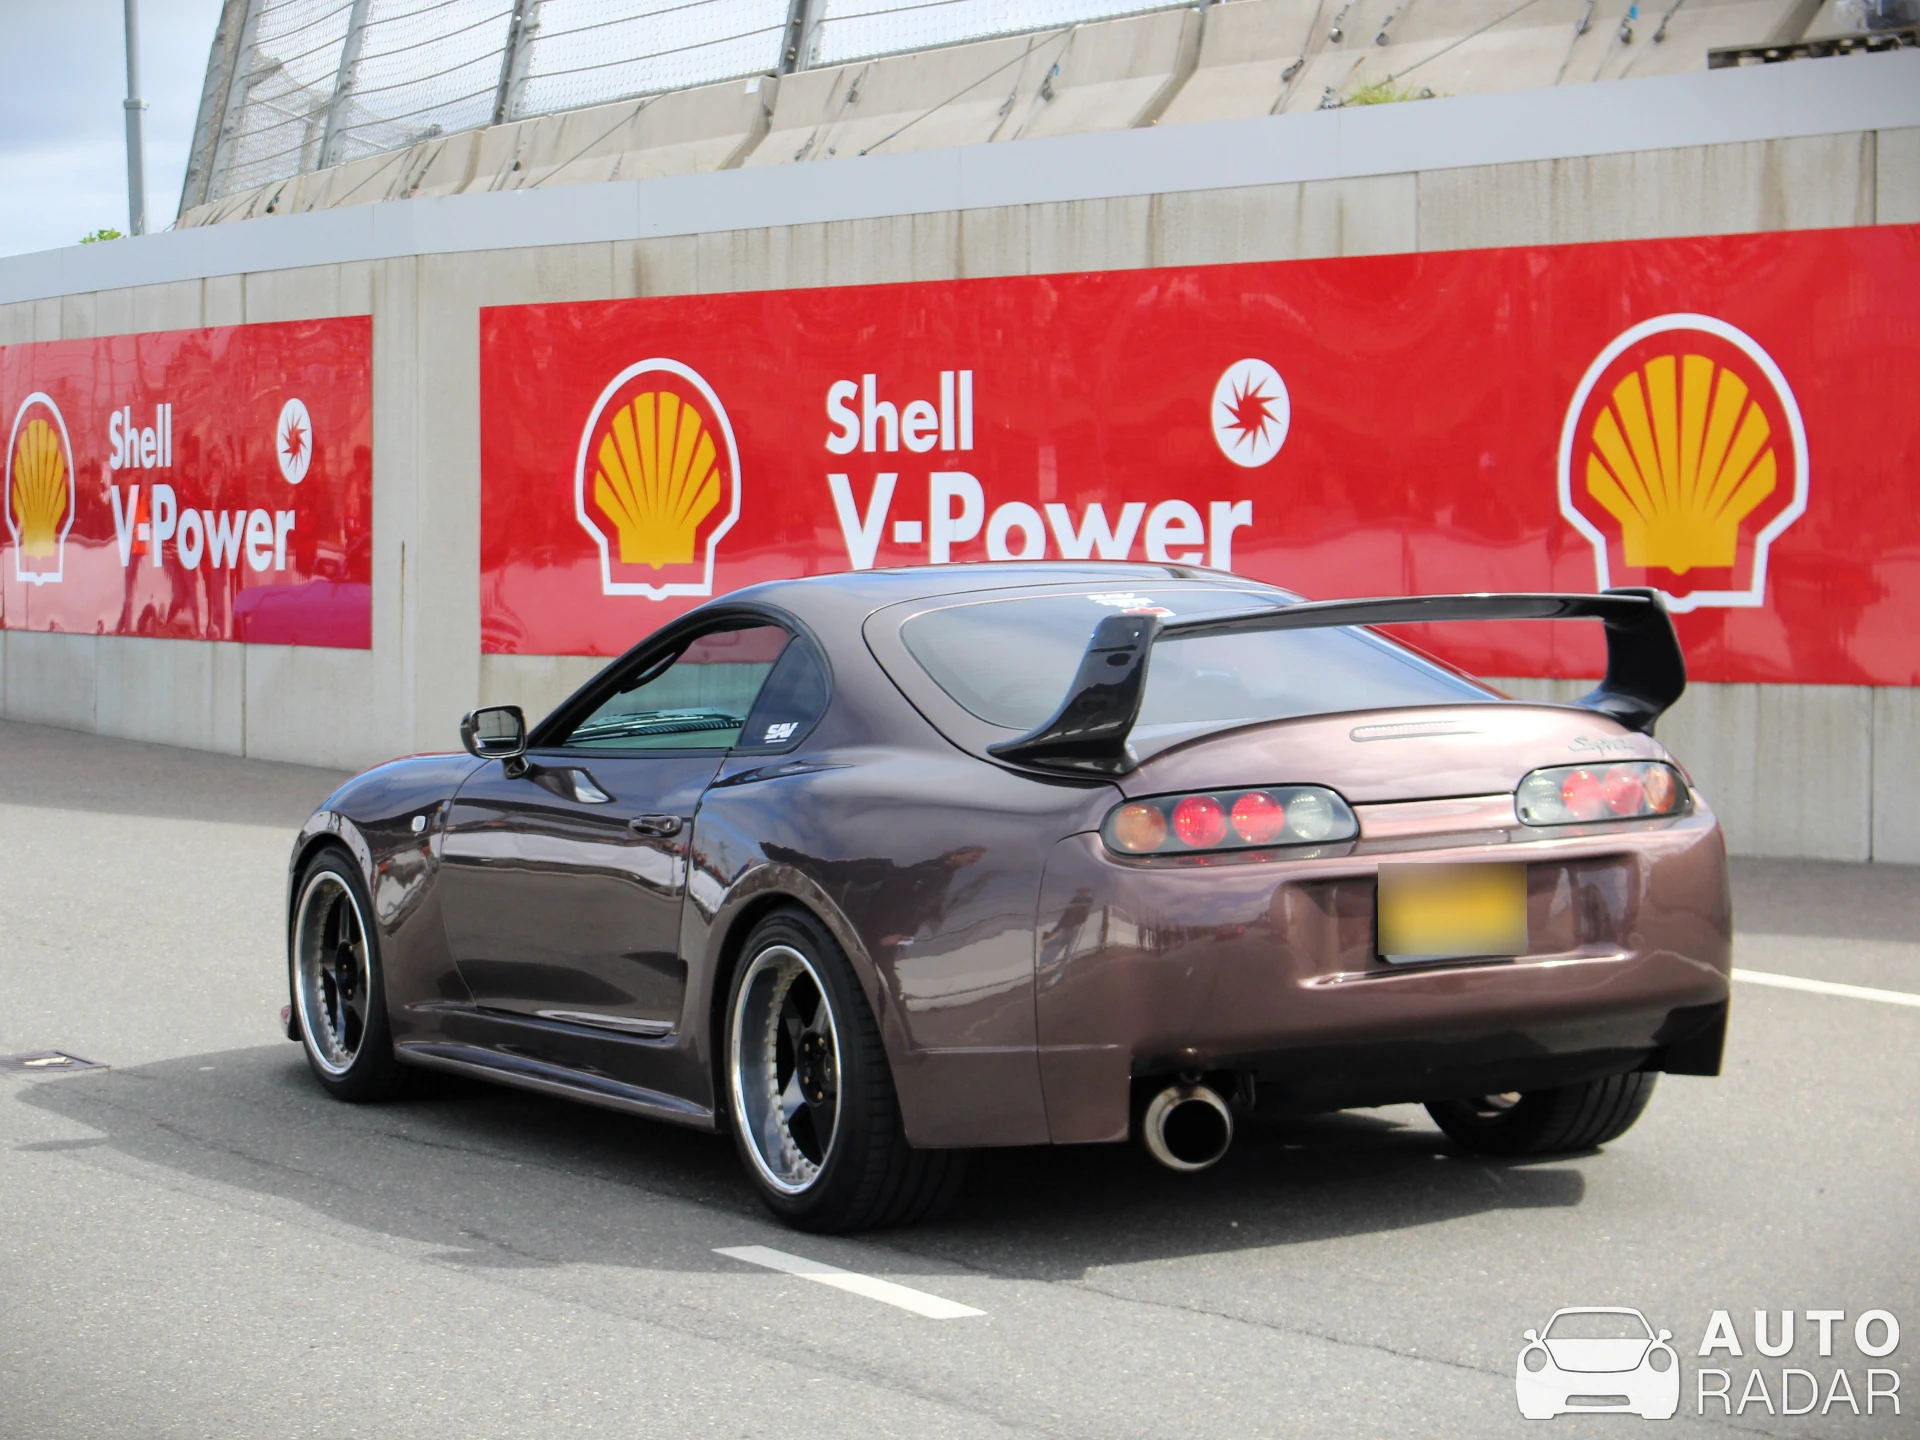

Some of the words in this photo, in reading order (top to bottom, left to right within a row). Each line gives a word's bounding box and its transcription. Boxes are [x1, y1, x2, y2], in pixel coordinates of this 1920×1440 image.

[110, 403, 172, 470] Shell
[825, 370, 973, 455] Shell
[111, 484, 296, 572] V-Power
[827, 471, 1253, 573] V-Power
